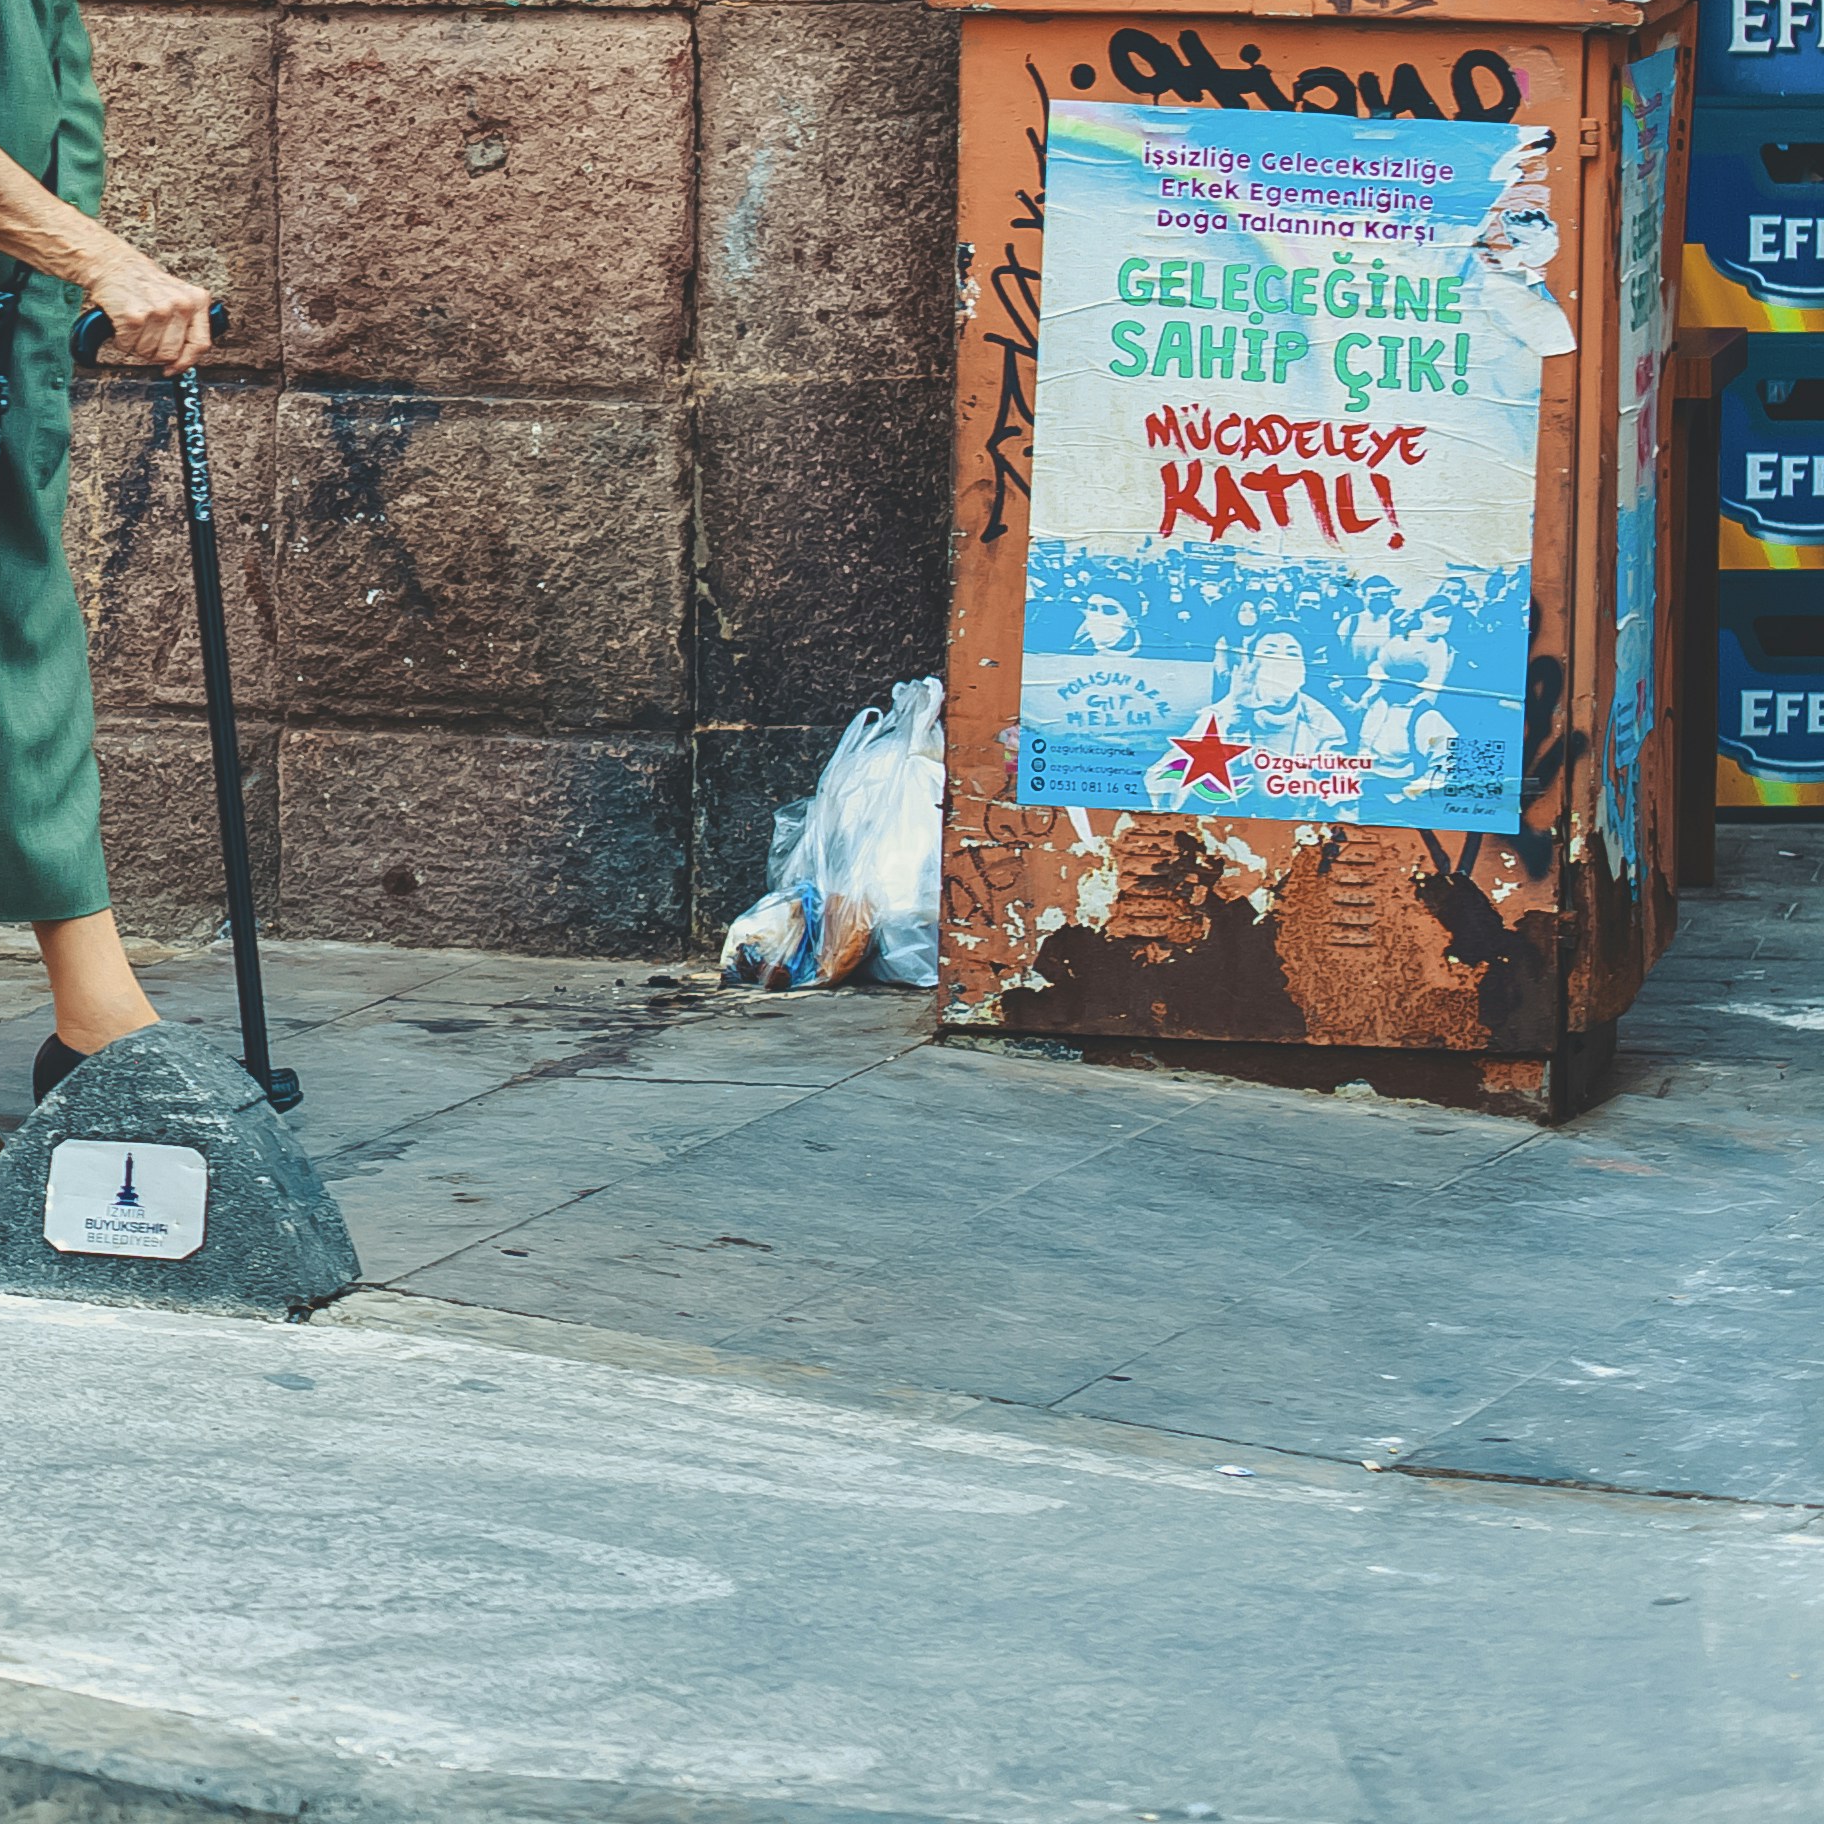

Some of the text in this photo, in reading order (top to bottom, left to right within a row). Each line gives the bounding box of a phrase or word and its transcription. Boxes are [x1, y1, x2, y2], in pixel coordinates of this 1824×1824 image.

[1144, 140, 1251, 174] İşsizliğe
[1161, 178, 1435, 213] Erkek Egemenliğine
[1156, 208, 1435, 247] Doğa Talanına Karşı
[1118, 251, 1466, 325] GELECEĞİNE
[1109, 310, 1471, 413] SAHİP ÇIK!
[1145, 403, 1429, 469] MÜCADELEYE
[1159, 458, 1406, 552] KATIL!
[1049, 779, 1139, 795] 0531 081 16 92
[1267, 774, 1361, 800] Gençlik
